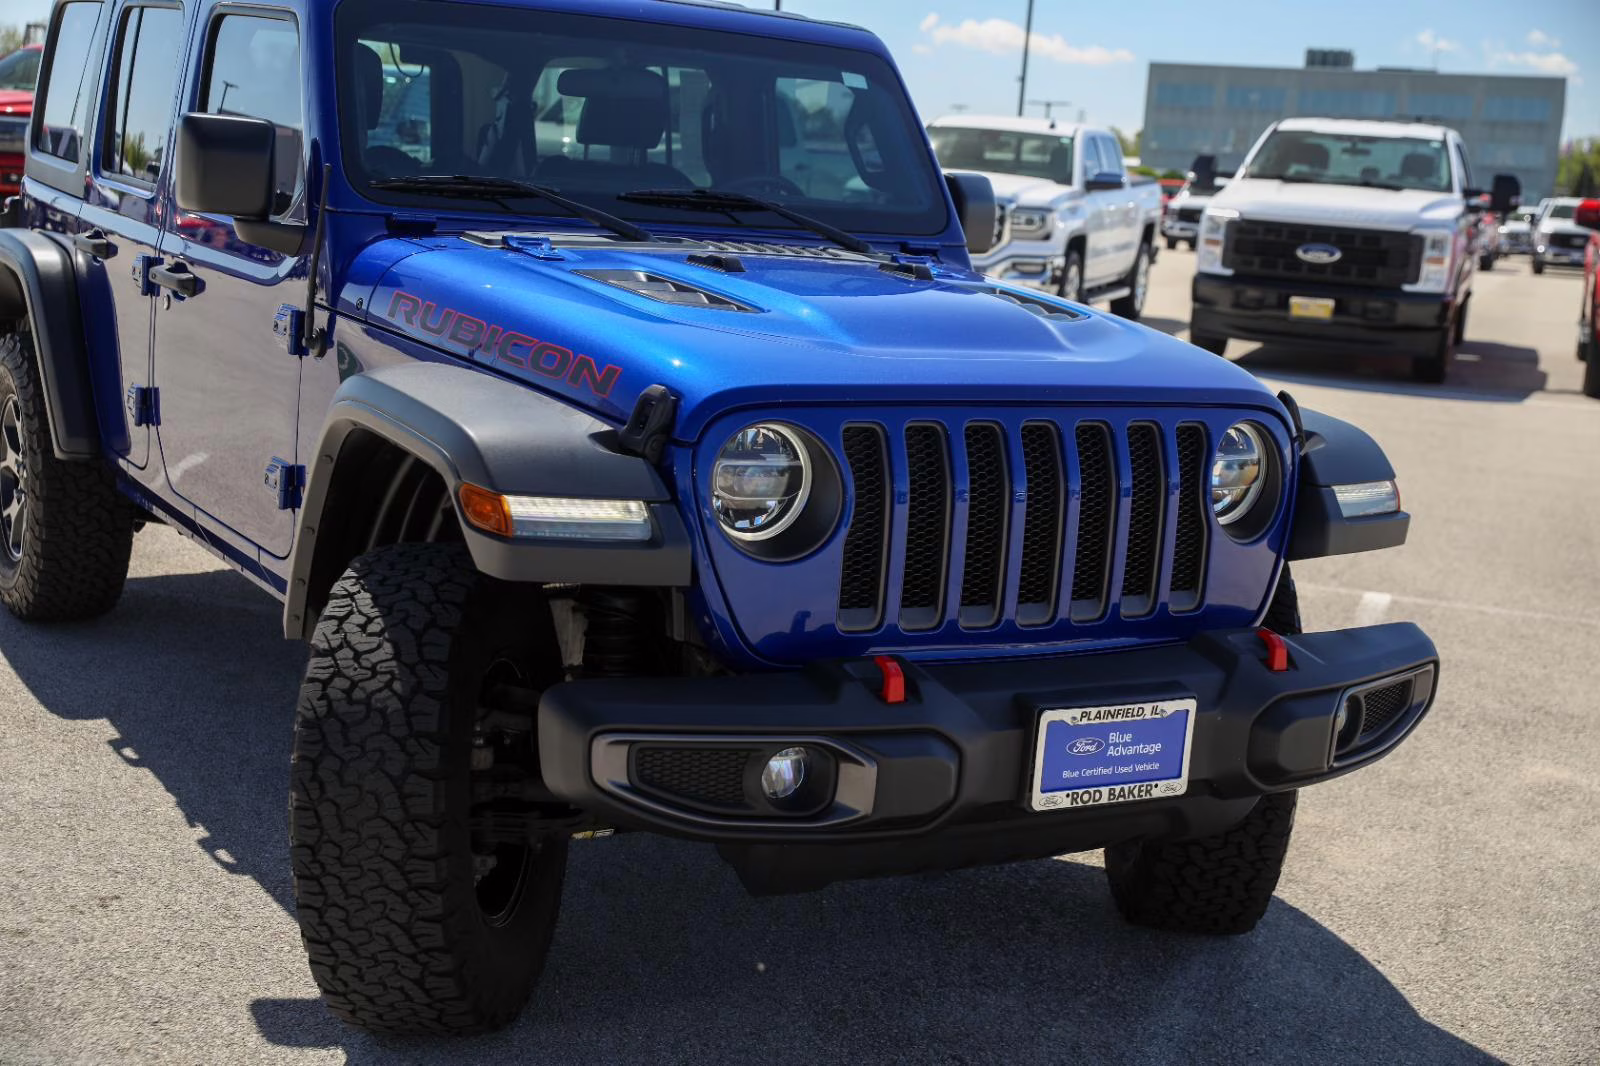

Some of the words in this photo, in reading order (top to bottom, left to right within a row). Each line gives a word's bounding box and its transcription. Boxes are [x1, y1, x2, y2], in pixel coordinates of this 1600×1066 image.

[387, 290, 622, 398] RUBICON
[1080, 707, 1146, 721] PLAINFIELD,
[1150, 705, 1160, 716] IL
[1073, 740, 1098, 752] Ford
[1109, 732, 1132, 744] Blue
[1106, 743, 1162, 756] Advantage
[1062, 770, 1080, 779] Blue
[1081, 766, 1112, 777] Certified
[1114, 765, 1133, 774] Used
[1135, 762, 1160, 772] Vehicle
[1070, 789, 1103, 806] ROD
[1107, 783, 1153, 802] BAKER
